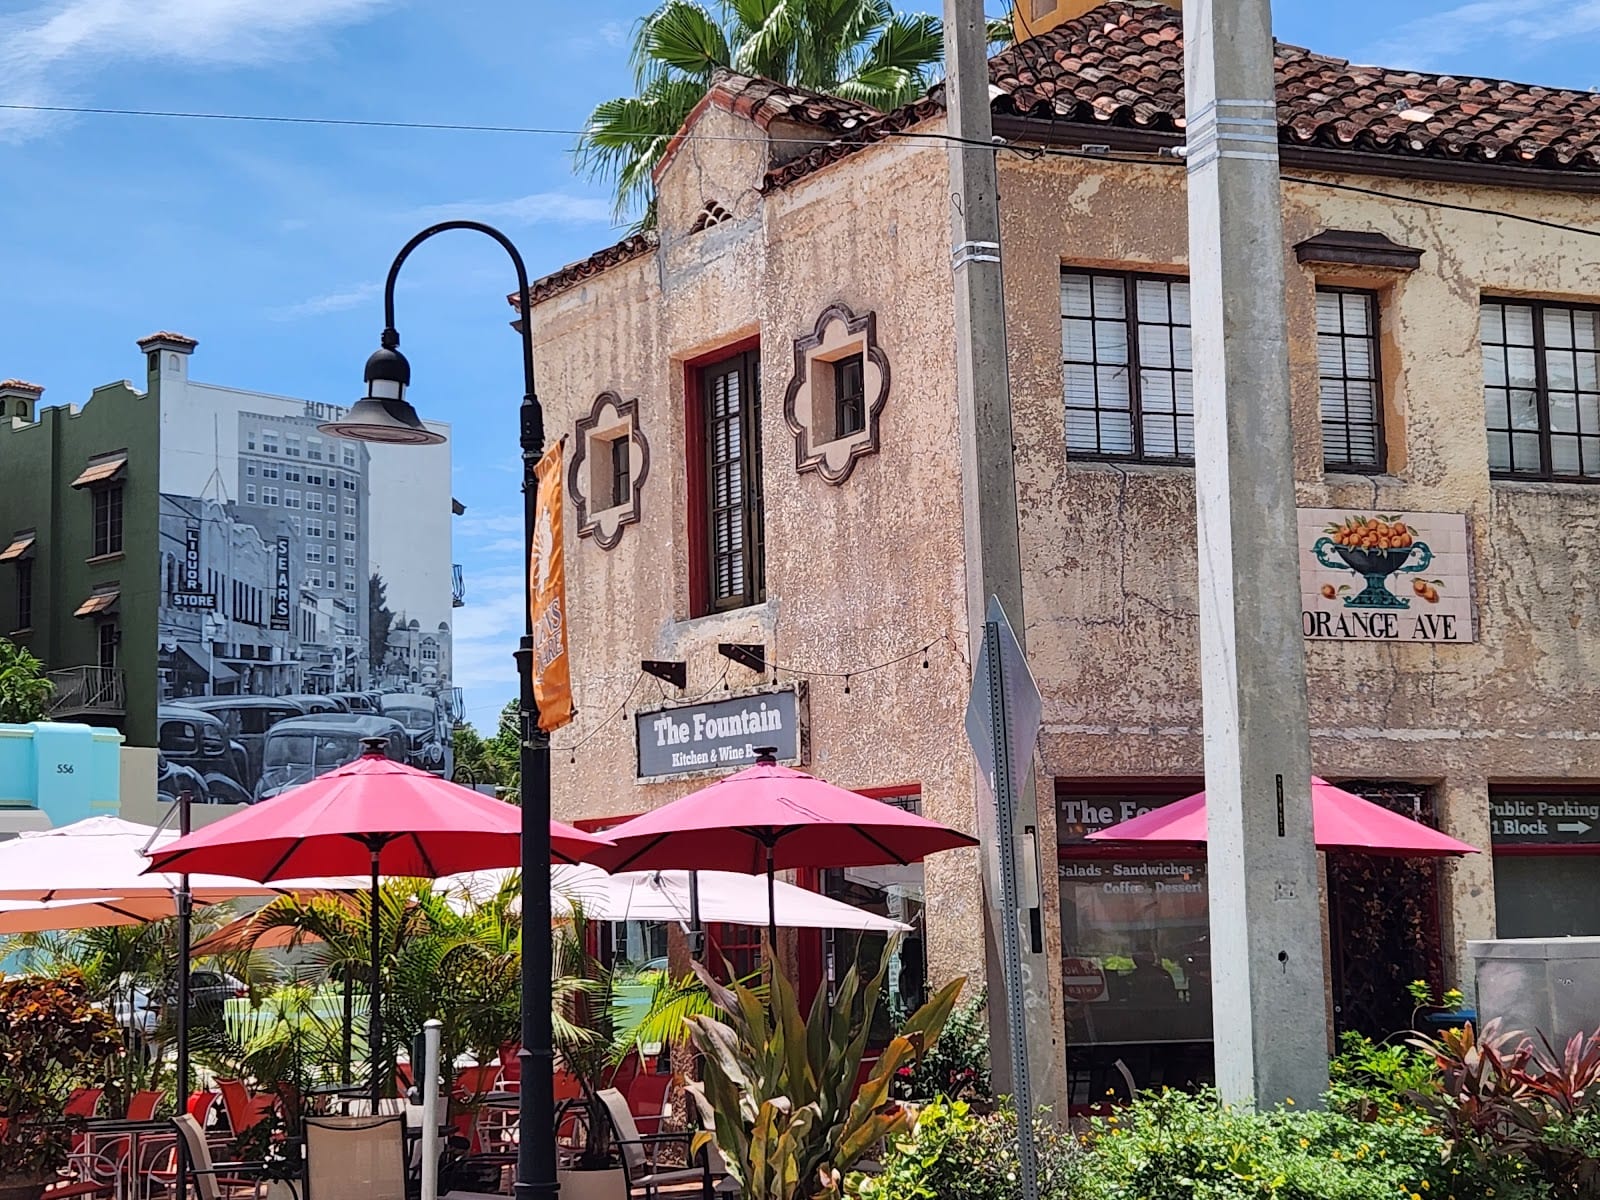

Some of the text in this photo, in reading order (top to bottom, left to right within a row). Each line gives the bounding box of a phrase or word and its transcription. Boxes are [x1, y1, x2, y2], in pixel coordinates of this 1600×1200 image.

[305, 400, 349, 421] HOTE
[187, 531, 198, 589] LIQUOR
[277, 540, 288, 616] SEARS
[174, 594, 214, 606] STORE
[1302, 611, 1457, 640] ORANGE AVE
[653, 702, 782, 747] The Fountain
[671, 750, 709, 767] Kitchen
[710, 749, 718, 763] &
[718, 745, 744, 762] Wine
[56, 764, 74, 774] 556
[1062, 800, 1113, 824] The
[1537, 800, 1600, 820] Parking
[1491, 819, 1548, 835] 1 Block
[1058, 864, 1102, 877] Salads
[1112, 863, 1194, 876] Sandwiches
